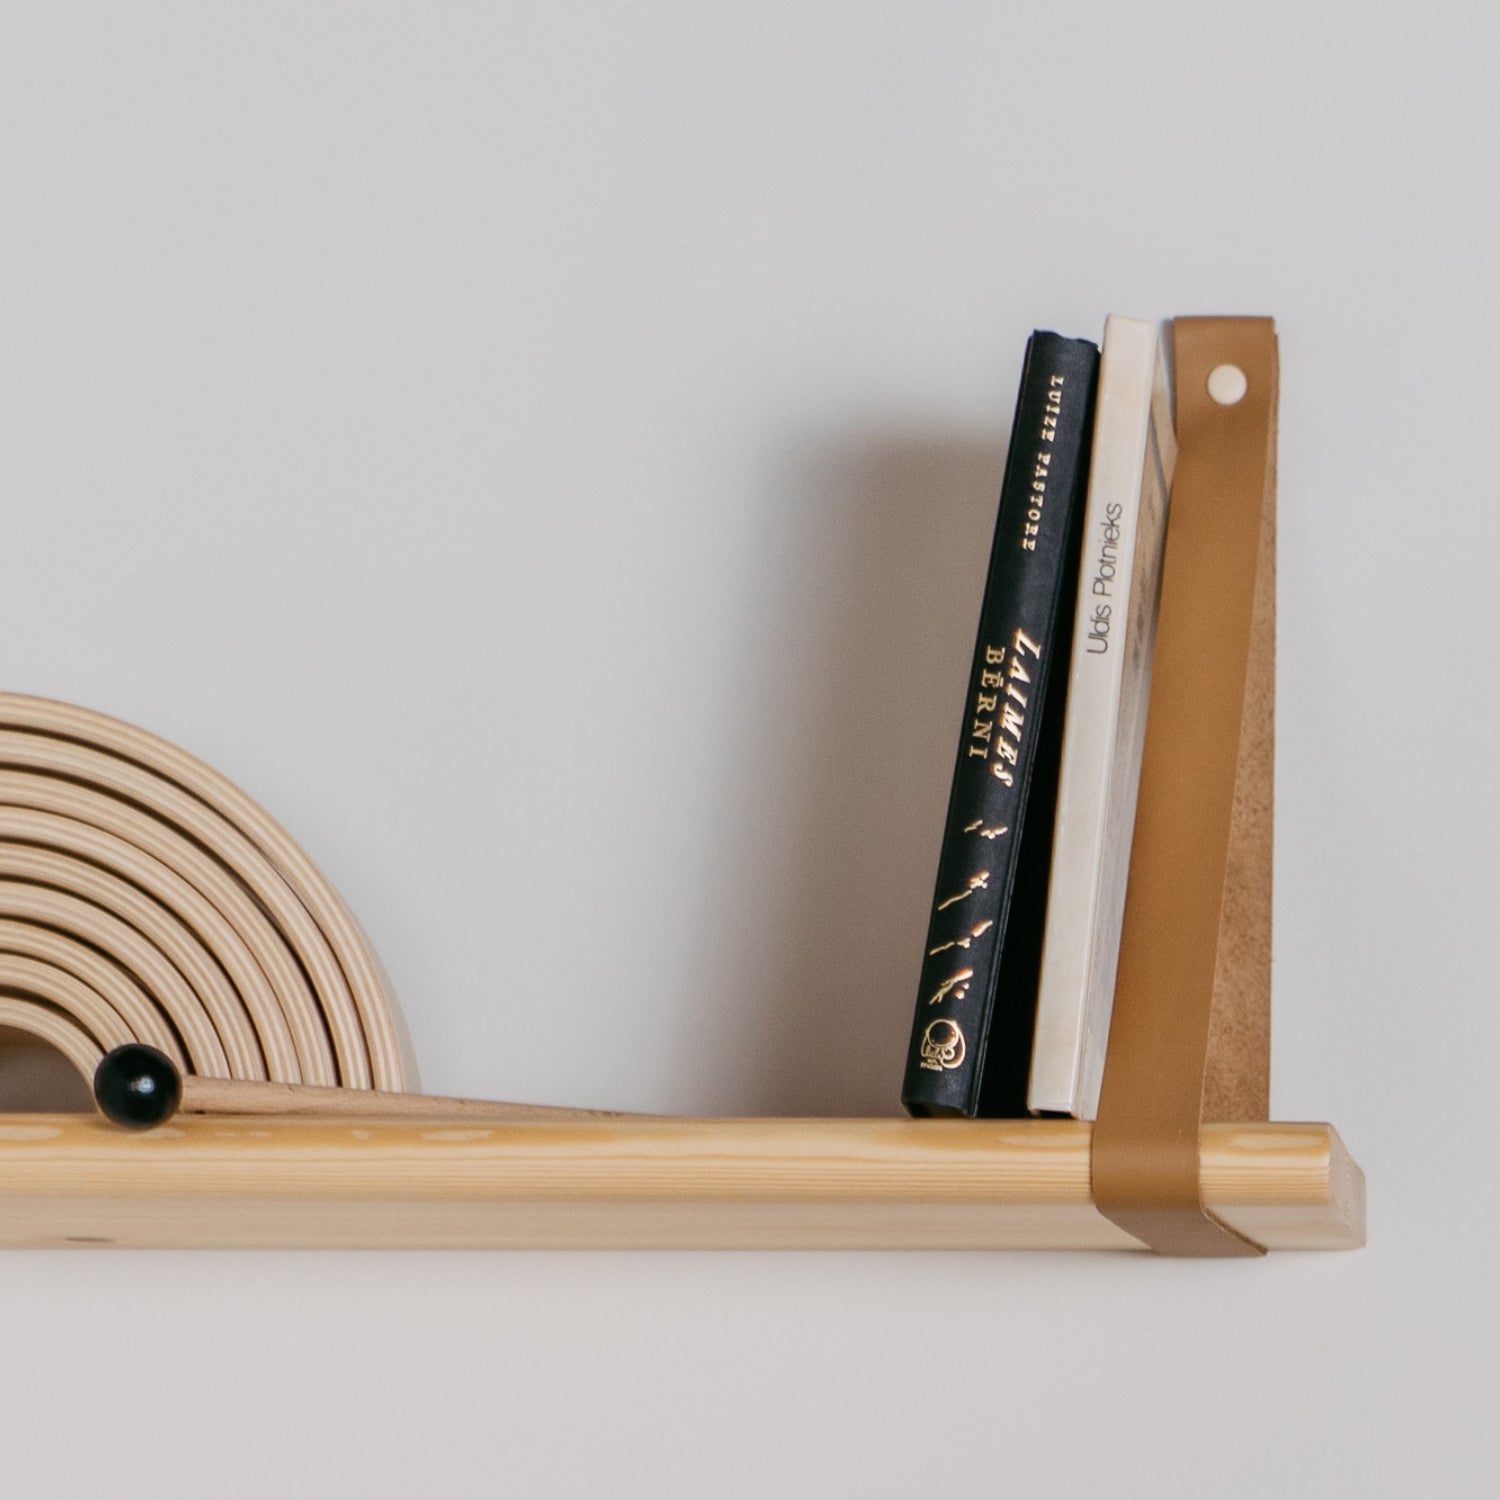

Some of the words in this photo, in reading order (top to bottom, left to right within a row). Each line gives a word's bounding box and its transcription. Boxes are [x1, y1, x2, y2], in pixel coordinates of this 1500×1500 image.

[1022, 452, 1051, 551] PASTORE
[1092, 502, 1123, 598] Plotnieks
[1086, 605, 1113, 656] Uldis
[968, 645, 1005, 760] BĒRNI
[990, 627, 1042, 788] LAIMES
